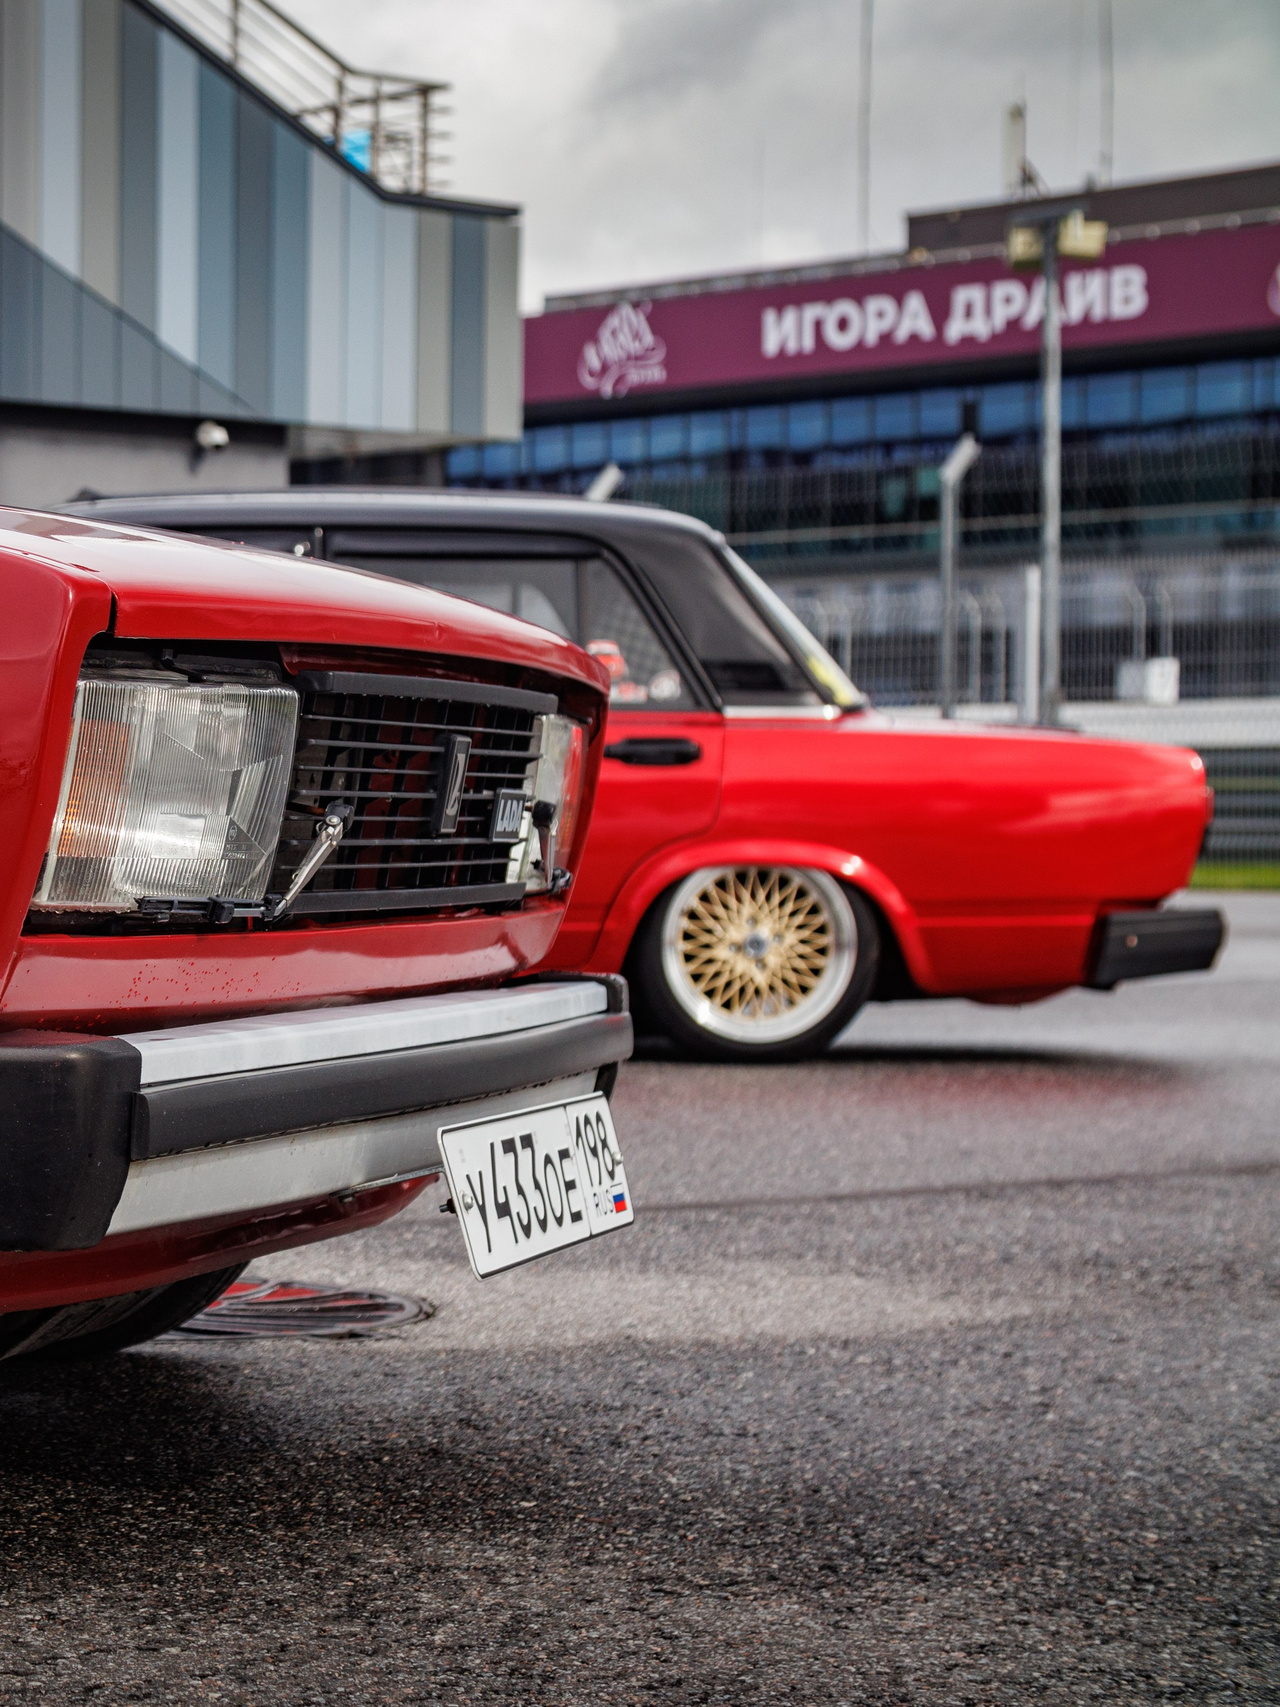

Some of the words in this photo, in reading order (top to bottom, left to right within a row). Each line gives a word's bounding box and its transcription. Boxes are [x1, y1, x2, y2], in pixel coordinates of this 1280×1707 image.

[760, 289, 937, 359] ИГОРА
[496, 799, 524, 832] LADA
[575, 1111, 616, 1187] 198
[593, 1189, 615, 1218] RUS
